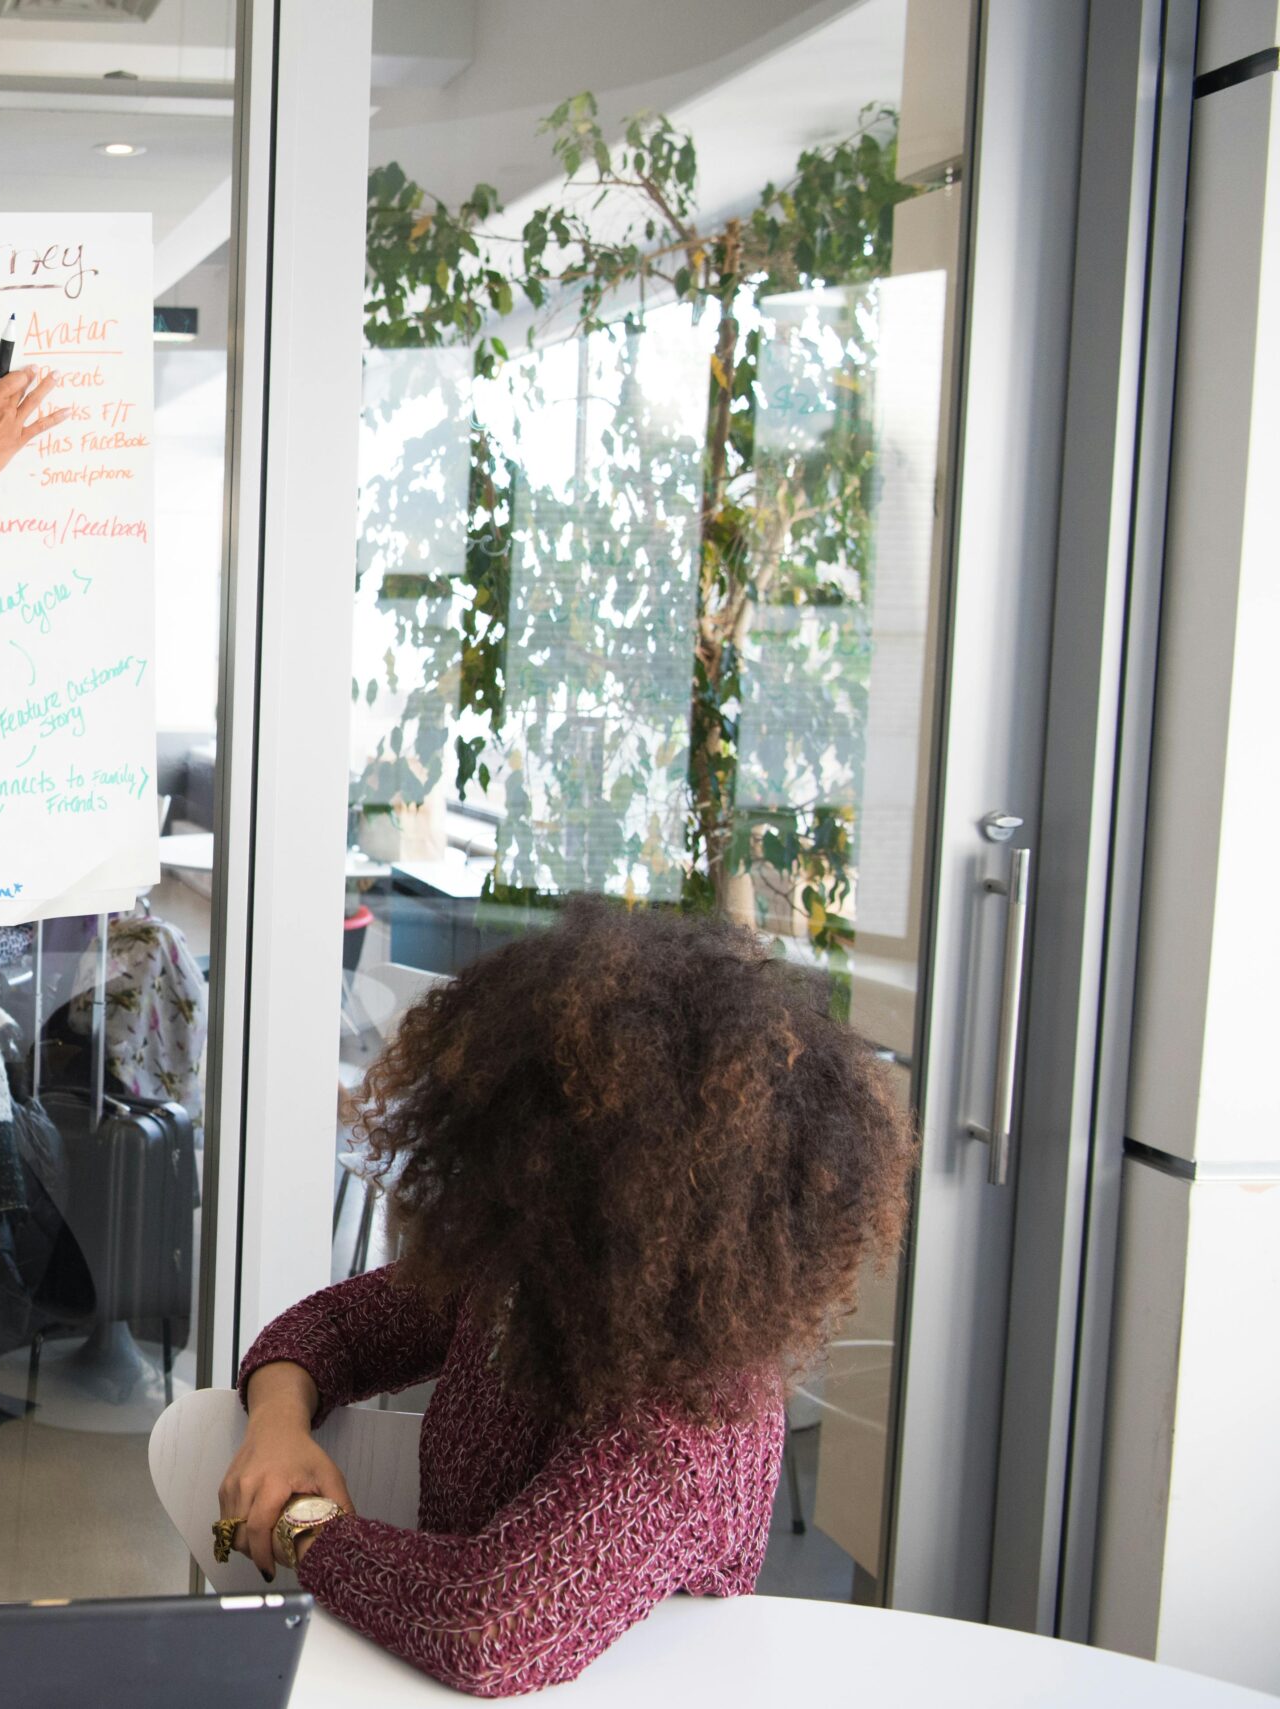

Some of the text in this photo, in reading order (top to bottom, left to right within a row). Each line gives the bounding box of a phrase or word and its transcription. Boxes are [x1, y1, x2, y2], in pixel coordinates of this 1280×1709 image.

[23, 311, 120, 351] Avatar
[102, 398, 136, 428] F/T
[67, 764, 86, 789] to
